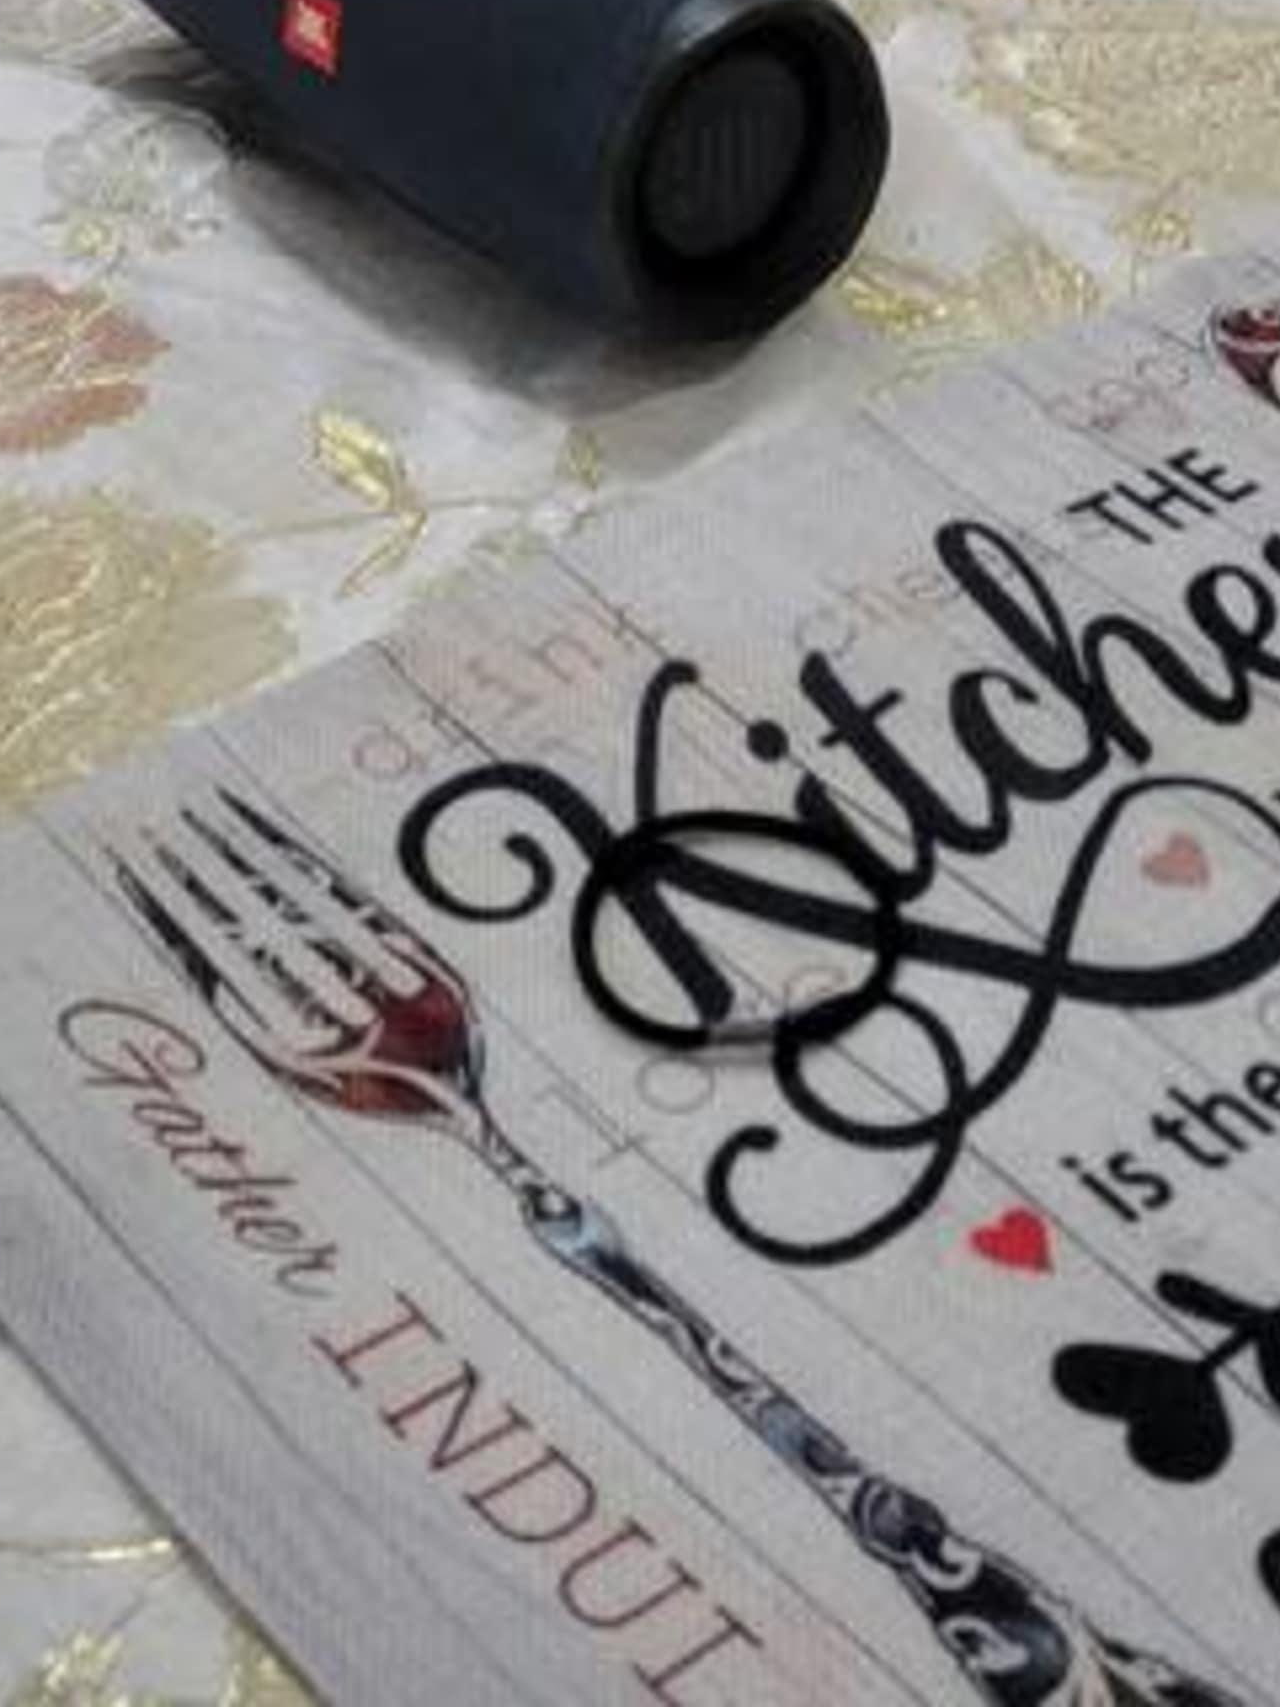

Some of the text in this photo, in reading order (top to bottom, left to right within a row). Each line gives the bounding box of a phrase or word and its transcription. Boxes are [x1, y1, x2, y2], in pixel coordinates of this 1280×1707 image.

[1064, 446, 1261, 547] THE
[57, 999, 340, 1298] Gather
[1059, 1148, 1175, 1225] is
